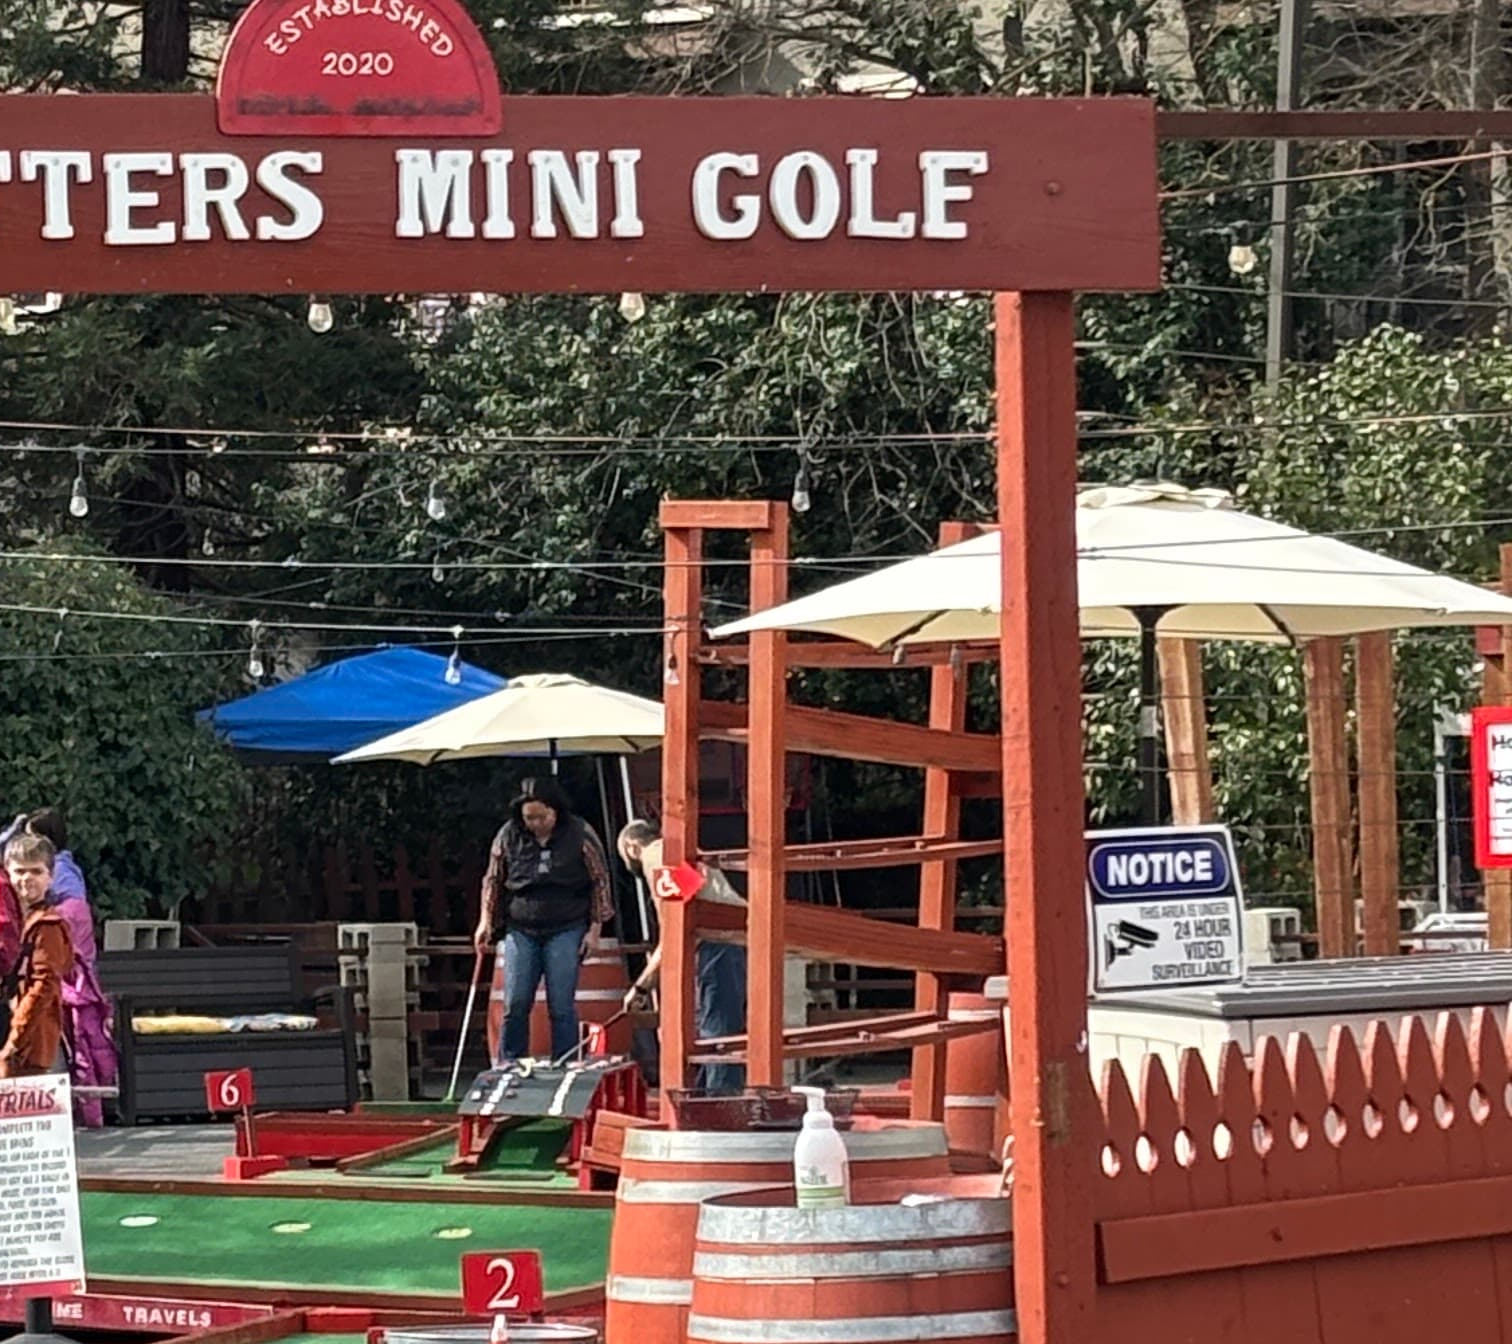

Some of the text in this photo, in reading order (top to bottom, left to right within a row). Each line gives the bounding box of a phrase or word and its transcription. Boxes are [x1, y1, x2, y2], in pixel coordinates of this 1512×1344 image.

[321, 51, 394, 76] 2020
[395, 148, 645, 239] MINI
[692, 148, 988, 240] GOLF
[1106, 849, 1214, 887] NOTICE
[1173, 917, 1232, 940] 24 HOUR
[1183, 940, 1225, 960] VIDEO
[219, 1073, 240, 1107] 6
[486, 1257, 520, 1309] 2
[123, 1305, 212, 1327] TRAVELS
